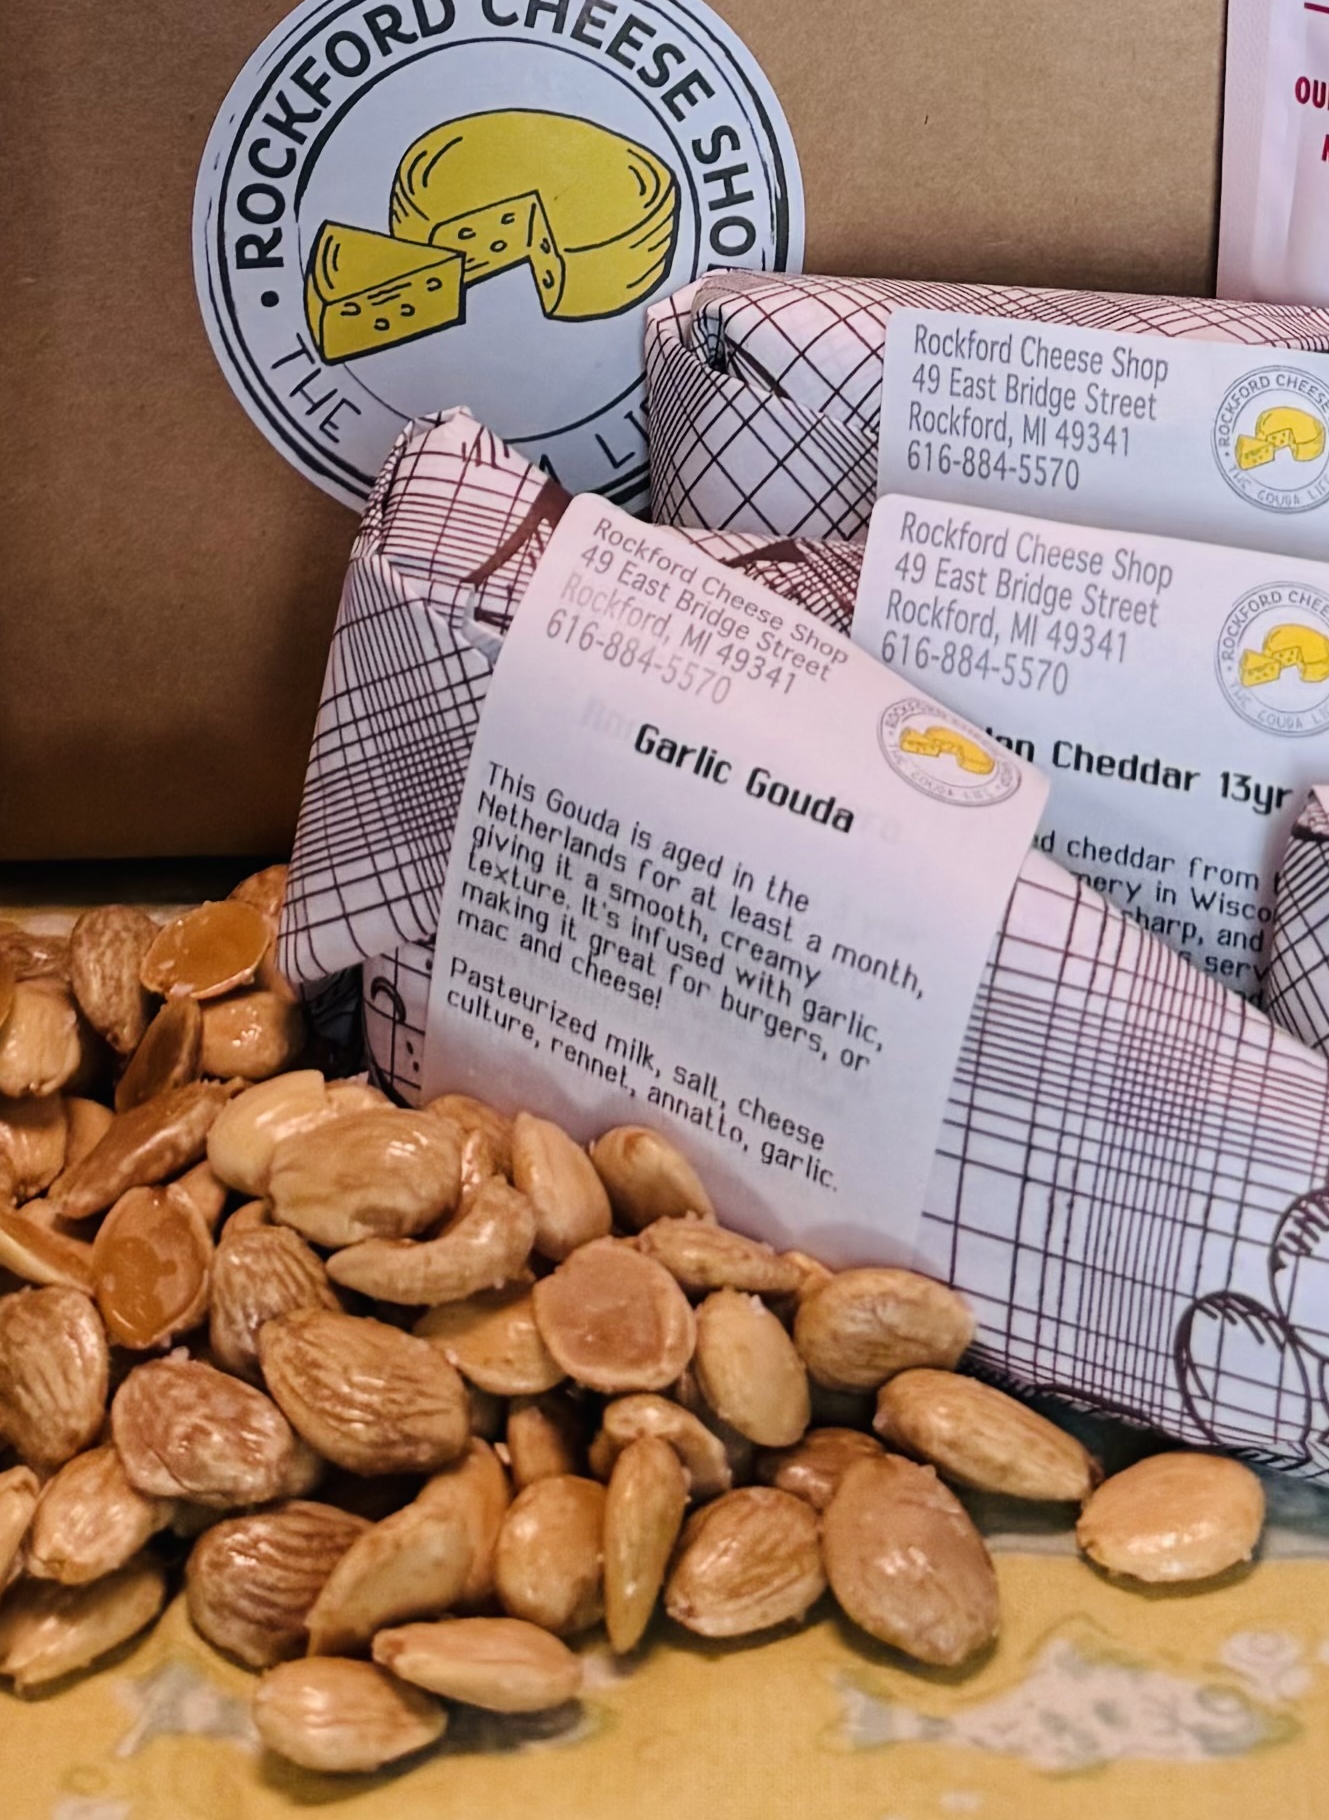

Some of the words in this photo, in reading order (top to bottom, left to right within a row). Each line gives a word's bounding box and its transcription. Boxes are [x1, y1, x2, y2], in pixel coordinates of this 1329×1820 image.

[692, 124, 758, 271] SHO
[272, 332, 362, 444] THE
[911, 363, 940, 394] 49
[950, 367, 996, 401] East
[1004, 372, 1076, 420] Bridge
[1084, 383, 1156, 422] Street
[914, 323, 1012, 365] Rockford
[1021, 335, 1103, 375] Cheese
[1110, 345, 1169, 389] Shop
[908, 401, 1014, 449] Rockford,
[1023, 420, 1047, 448] MI
[1055, 422, 1129, 457] 49341
[1218, 375, 1271, 447] ROCKFORD
[906, 439, 1080, 490] 616-884-5570
[894, 552, 926, 585] 49
[935, 557, 988, 597] East
[995, 564, 1072, 614] Bridge
[1081, 586, 1158, 629] Street
[900, 511, 1008, 559] Rockford
[1016, 533, 1103, 576] Cheese
[1111, 547, 1173, 594] Shop
[881, 631, 1070, 696] 616-884-5570
[886, 590, 1000, 645] Rockford,
[1010, 615, 1038, 648] MI
[1047, 622, 1127, 664] 49341
[634, 723, 734, 785] Garlic
[745, 767, 855, 834] Gouda
[1052, 740, 1200, 791] Cheddar
[1220, 771, 1293, 815] 13yr
[487, 762, 536, 803] This
[546, 787, 619, 837] Gouda
[630, 821, 653, 849] is
[662, 841, 723, 880] aged
[732, 862, 755, 892] in
[766, 875, 809, 914] the
[1067, 836, 1175, 873] cheddar
[1189, 857, 1259, 891] from
[472, 823, 544, 875] giving
[556, 853, 574, 881] it
[585, 871, 599, 891] a
[609, 882, 710, 942] smooth,
[721, 928, 822, 988] creamy
[477, 791, 626, 873] Netherlands
[638, 860, 681, 892] for
[691, 884, 716, 912] at
[730, 896, 795, 942] least
[805, 930, 821, 953] a
[832, 942, 925, 1000] month,
[1155, 881, 1177, 904] in
[1191, 887, 1272, 923] Wisco
[457, 908, 508, 942] mac
[519, 932, 562, 964] and
[571, 951, 663, 1010] cheese!
[462, 880, 549, 932] making
[561, 913, 577, 941] it
[589, 932, 655, 979] great
[669, 964, 712, 997] for
[721, 985, 828, 1062] burgers,
[840, 1048, 871, 1073] or
[468, 847, 570, 912] texture.
[581, 895, 620, 930] It's
[630, 914, 724, 976] infused
[735, 963, 792, 1007] with
[802, 995, 884, 1052] garlic,
[447, 988, 540, 1049] culture,
[550, 1037, 637, 1098] rennet,
[647, 1083, 750, 1153] annatto,
[760, 1135, 838, 1192] garlic.
[450, 956, 597, 1042] Pasteurized
[605, 1032, 661, 1078] milk,
[673, 1064, 727, 1111] salt,
[738, 1094, 825, 1150] cheese
